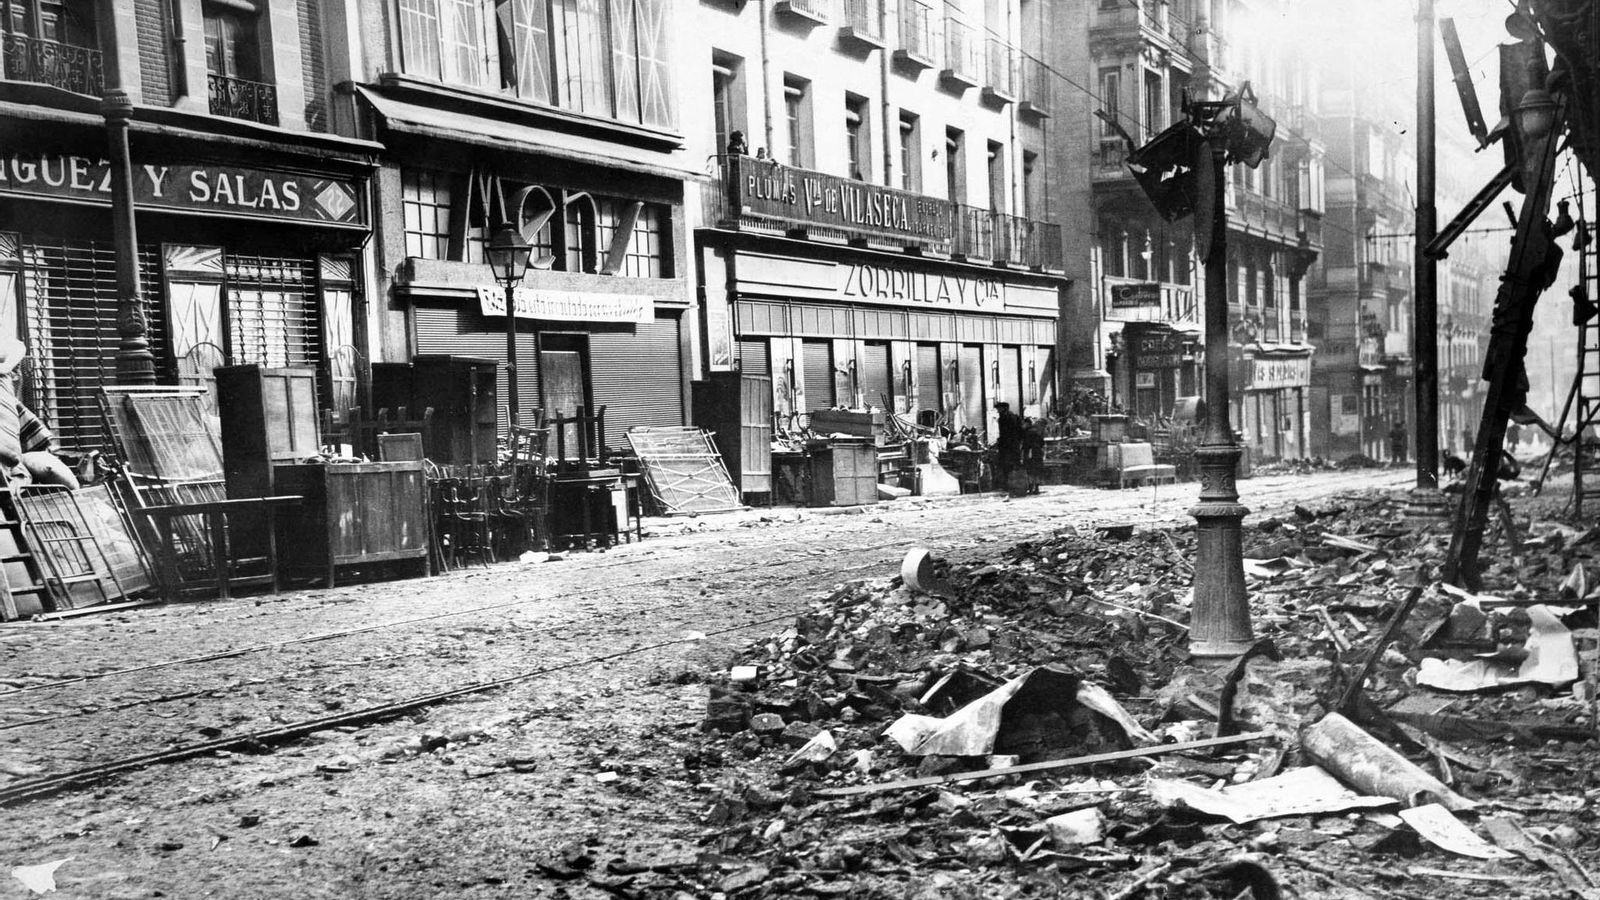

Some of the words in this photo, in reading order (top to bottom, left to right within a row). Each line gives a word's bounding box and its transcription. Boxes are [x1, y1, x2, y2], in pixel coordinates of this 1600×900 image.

[144, 165, 169, 197] Y
[189, 170, 301, 211] SALAS
[748, 175, 797, 204] PLUMAS
[825, 188, 837, 213] DE
[843, 263, 951, 303] ZORRILLA
[955, 274, 967, 304] Y
